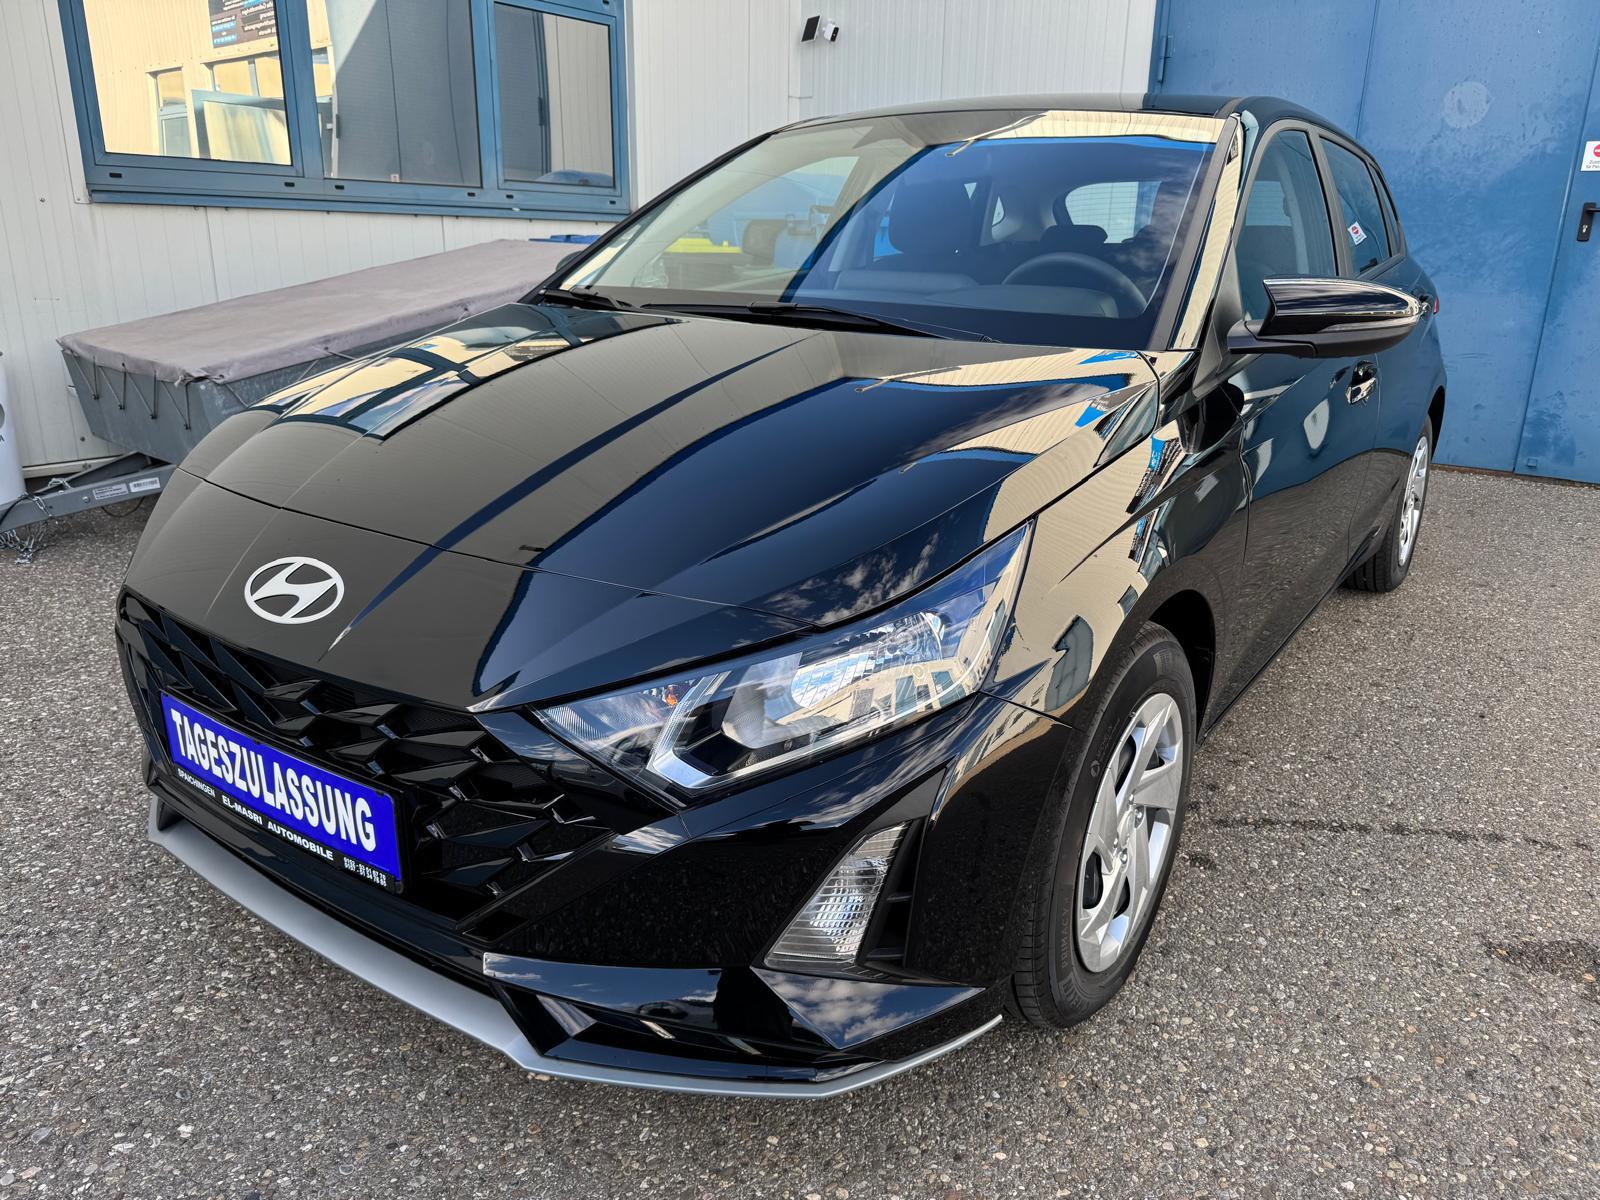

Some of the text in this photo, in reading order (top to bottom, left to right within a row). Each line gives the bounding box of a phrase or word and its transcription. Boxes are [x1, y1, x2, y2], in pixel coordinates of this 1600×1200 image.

[171, 708, 376, 852] TAGESZULASSUNG
[177, 768, 334, 861] SPAICHINGEN EL-MASRI AUTOMOBILE
